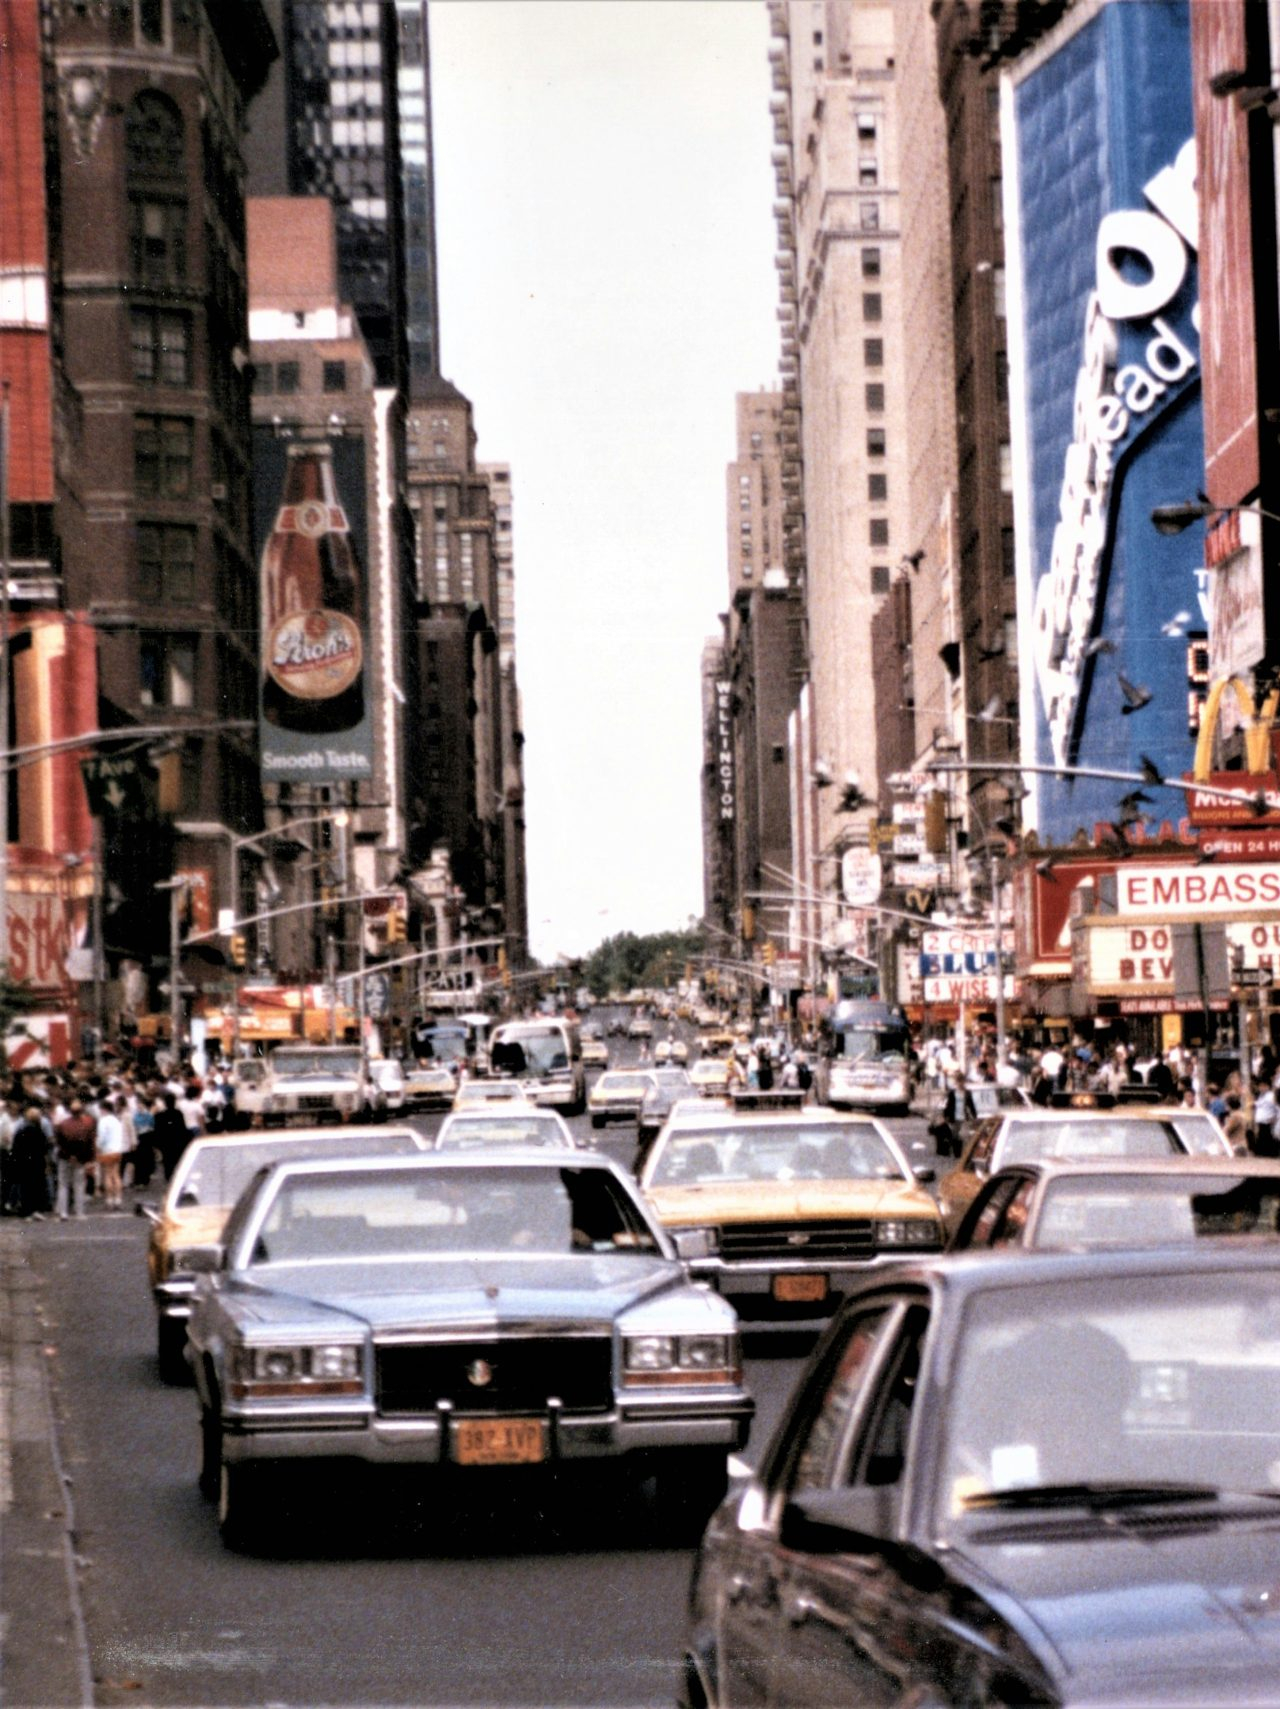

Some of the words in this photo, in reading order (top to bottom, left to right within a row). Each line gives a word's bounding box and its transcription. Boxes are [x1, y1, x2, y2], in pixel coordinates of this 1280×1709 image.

[262, 752, 324, 769] Smooth
[716, 681, 733, 819] WELLINGTON
[1248, 841, 1264, 853] 24
[1130, 929, 1169, 951] DO
[1119, 957, 1174, 980] BEV
[949, 979, 990, 1000] WISE
